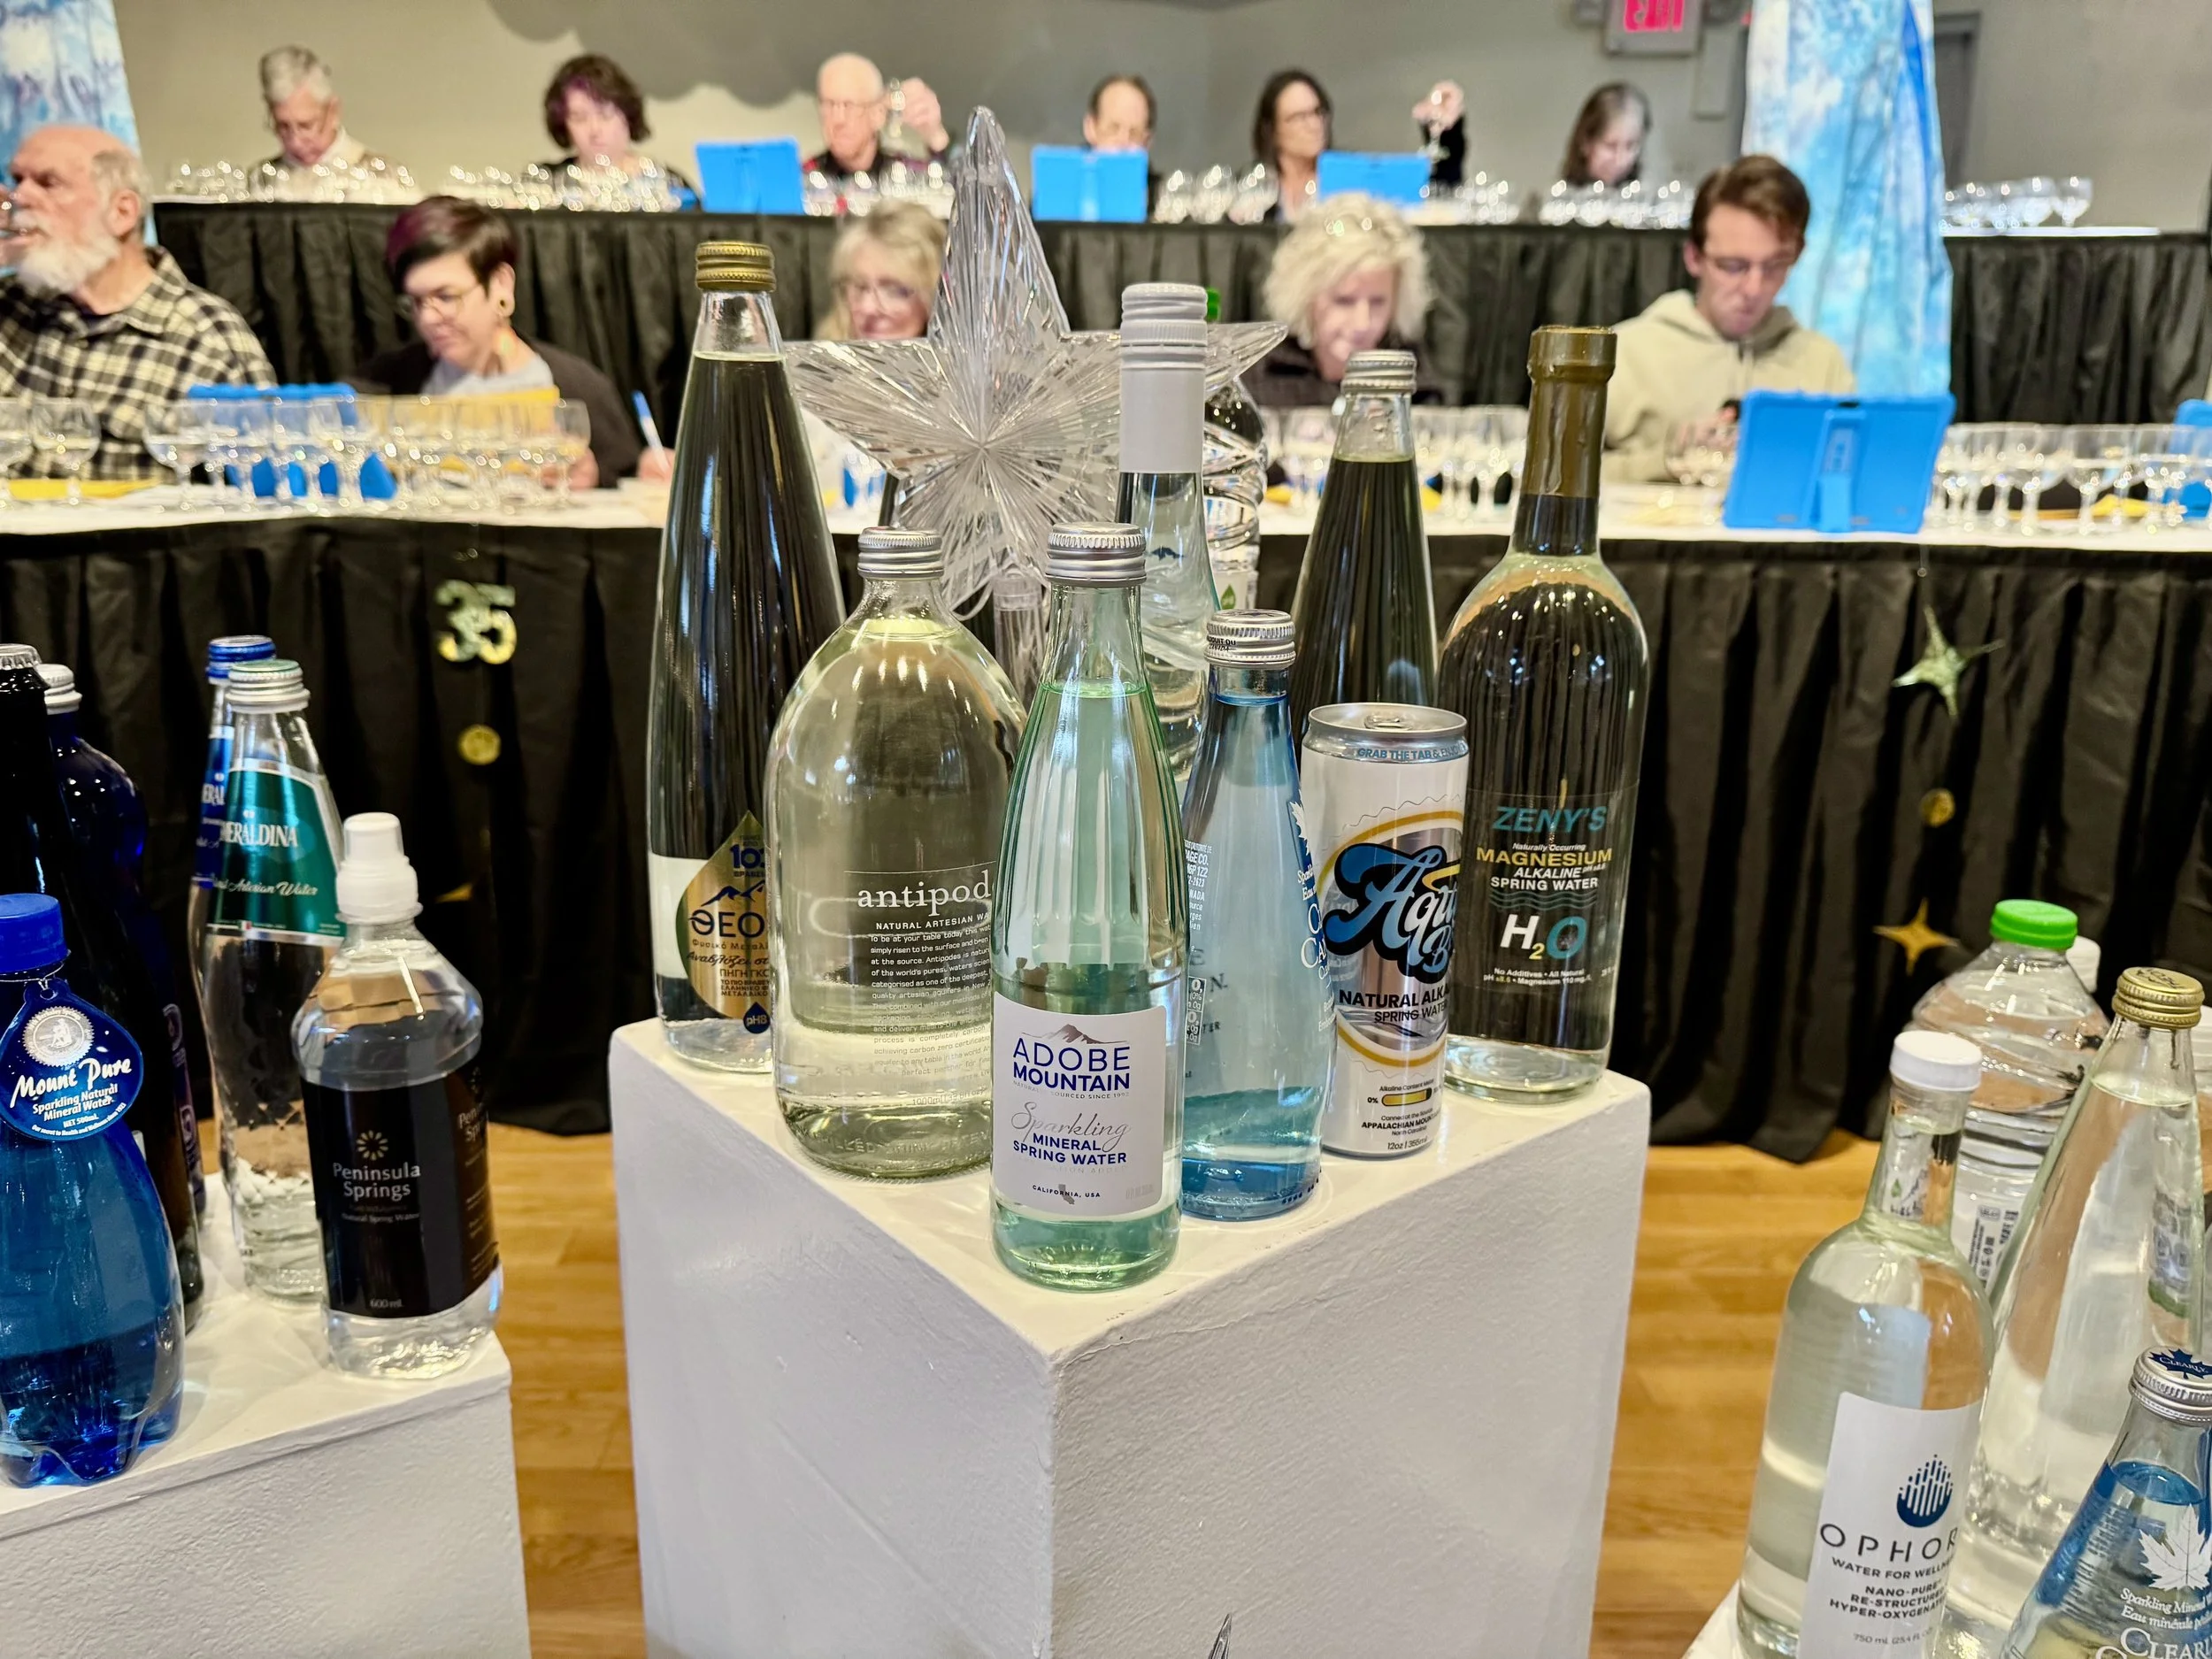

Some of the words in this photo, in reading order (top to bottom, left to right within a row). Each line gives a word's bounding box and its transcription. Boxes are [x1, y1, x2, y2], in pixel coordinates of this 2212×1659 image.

[436, 579, 518, 664] 35
[1357, 748, 1387, 758] GRAB
[1389, 750, 1409, 760] THE
[1411, 749, 1432, 760] TAB
[1492, 806, 1607, 833] ZENY'S
[220, 821, 298, 848] ERALDINA
[1512, 842, 1548, 852] Naturally
[1548, 843, 1586, 852] Occurring
[1476, 847, 1612, 867] MAGNESIUM
[1514, 867, 1581, 879] ALKALINE
[275, 880, 319, 896] Water
[857, 868, 992, 917] antipod
[1490, 877, 1548, 891] SPRING
[1553, 878, 1599, 891] WATER
[688, 909, 765, 938] ΘΕΟ
[926, 915, 973, 928] ARTESIAN
[943, 930, 963, 939] today
[934, 942, 960, 951] surface
[926, 954, 962, 964] Antipodes
[923, 966, 948, 976] purest
[949, 963, 972, 972] waters
[1507, 969, 1542, 978] Additives
[1560, 968, 1585, 977] Natural
[872, 980, 914, 989] categorised
[1517, 978, 1561, 987] Magnesium
[952, 995, 980, 1005] methods
[1339, 989, 1419, 1008] NATURAL
[1374, 1010, 1419, 1023] SPRING
[919, 1030, 959, 1042] completely
[962, 1025, 986, 1035] carbon
[1013, 1038, 1131, 1072] ADOBE
[10, 1068, 78, 1109] Mount
[78, 1057, 133, 1091] Pure
[1013, 1062, 1131, 1092] MOUNTAIN
[33, 1094, 80, 1115] Sparkling
[81, 1083, 119, 1102] Natural
[43, 1103, 81, 1122] Mineral
[83, 1095, 113, 1112] Water
[63, 1119, 76, 1128] NET
[1011, 1102, 1132, 1153] Sparkling
[1362, 1121, 1415, 1130] APPALACHIAN
[1033, 1133, 1102, 1151] MINERAL
[1013, 1140, 1066, 1164] SPRING
[1071, 1152, 1127, 1165] WATER
[333, 1162, 422, 1181] Peninsula
[343, 1182, 411, 1202] Springs
[1032, 1185, 1081, 1198] CALIFORNIA,
[2159, 1356, 2206, 1373] CLEARLY
[1832, 1556, 1881, 1578] WATER
[1885, 1571, 1911, 1579] FOR
[2120, 1587, 2173, 1615] Sparkling
[2121, 1604, 2147, 1624] Eau
